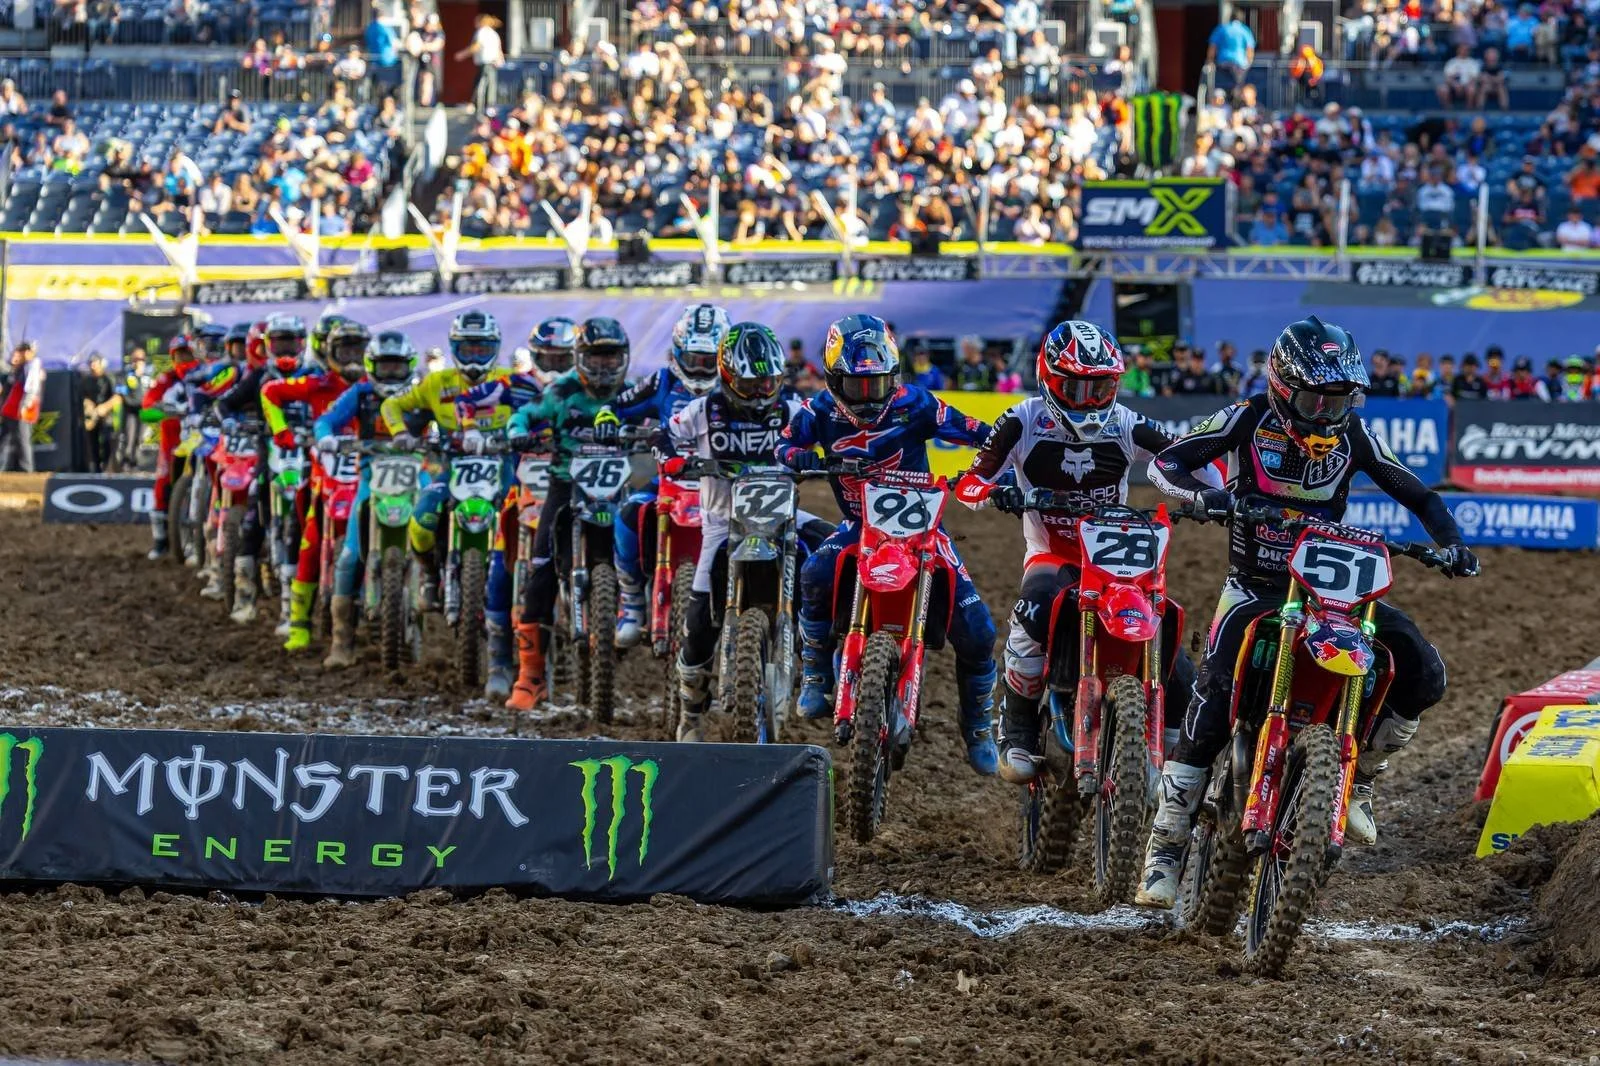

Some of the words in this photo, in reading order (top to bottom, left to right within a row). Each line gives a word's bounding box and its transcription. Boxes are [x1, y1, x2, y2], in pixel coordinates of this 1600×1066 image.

[1084, 188, 1214, 236] SMX
[377, 463, 417, 488] 719
[575, 460, 624, 487] 46
[735, 484, 791, 520] 32
[873, 493, 932, 530] 96
[1483, 503, 1576, 531] YAMAHA
[1092, 531, 1160, 568] 28
[1303, 545, 1377, 596] 51
[1323, 599, 1349, 608] DUCATI
[908, 664, 921, 725] DUNLOP
[86, 744, 529, 828] MONSTER
[152, 833, 457, 868] ENERGY
